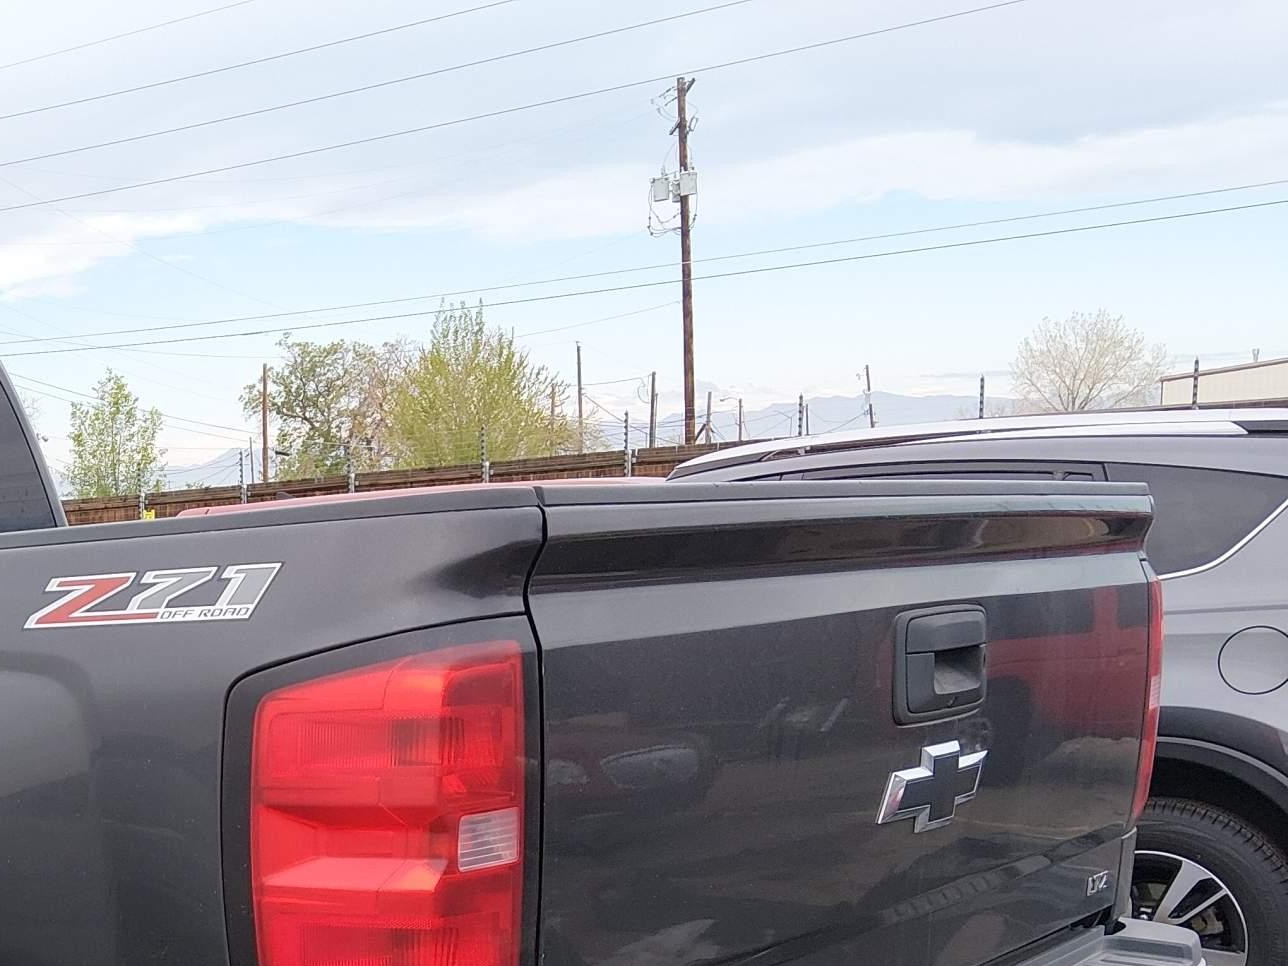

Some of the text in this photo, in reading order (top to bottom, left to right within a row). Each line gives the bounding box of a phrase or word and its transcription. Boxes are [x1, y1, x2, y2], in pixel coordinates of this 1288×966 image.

[24, 562, 284, 629] Z71
[160, 607, 250, 620] OFF ROAD
